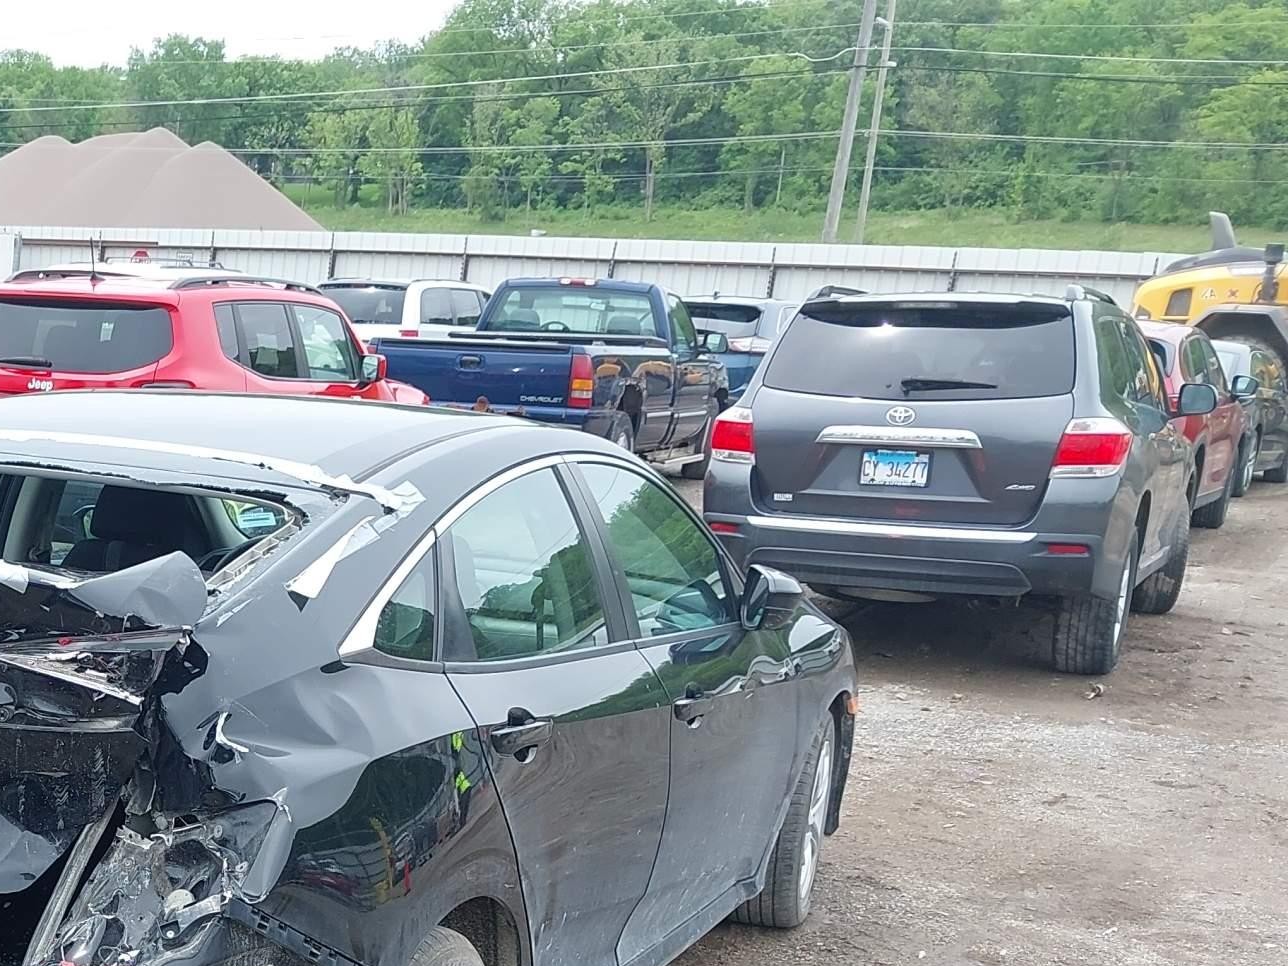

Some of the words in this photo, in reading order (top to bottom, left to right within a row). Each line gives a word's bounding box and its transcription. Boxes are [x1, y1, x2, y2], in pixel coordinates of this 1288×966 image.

[27, 377, 53, 392] Jeep
[520, 395, 563, 403] CHEVROLET
[863, 460, 879, 477] CY
[886, 461, 928, 479] 34277
